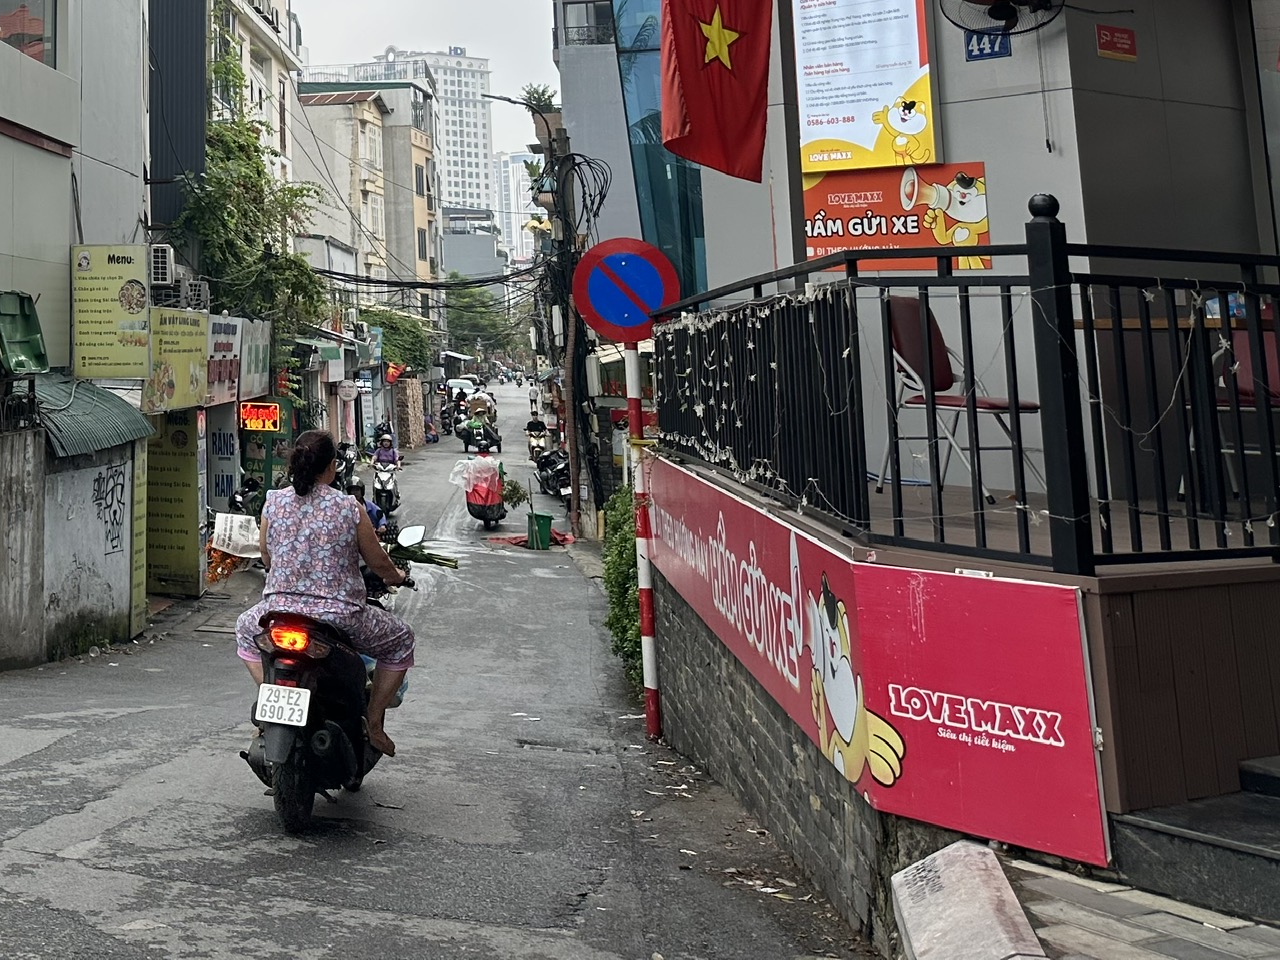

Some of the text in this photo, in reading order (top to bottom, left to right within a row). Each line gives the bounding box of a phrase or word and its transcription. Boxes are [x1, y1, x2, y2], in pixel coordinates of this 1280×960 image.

[968, 35, 1001, 55] 447
[806, 116, 855, 126] 0586-603-888
[809, 151, 852, 163] LOVE MAXX
[828, 191, 882, 205] LOVE MAXX
[848, 210, 887, 236] GỬI
[892, 215, 919, 234] XE
[265, 419, 274, 429] K
[212, 427, 234, 456] RĂNG
[214, 470, 234, 498] HÀM
[266, 688, 302, 707] 29-E2
[260, 704, 304, 723] 690.23
[888, 684, 1065, 747] LOVE MAXX
[937, 727, 1016, 753] Siêu thị tiết kiệm
